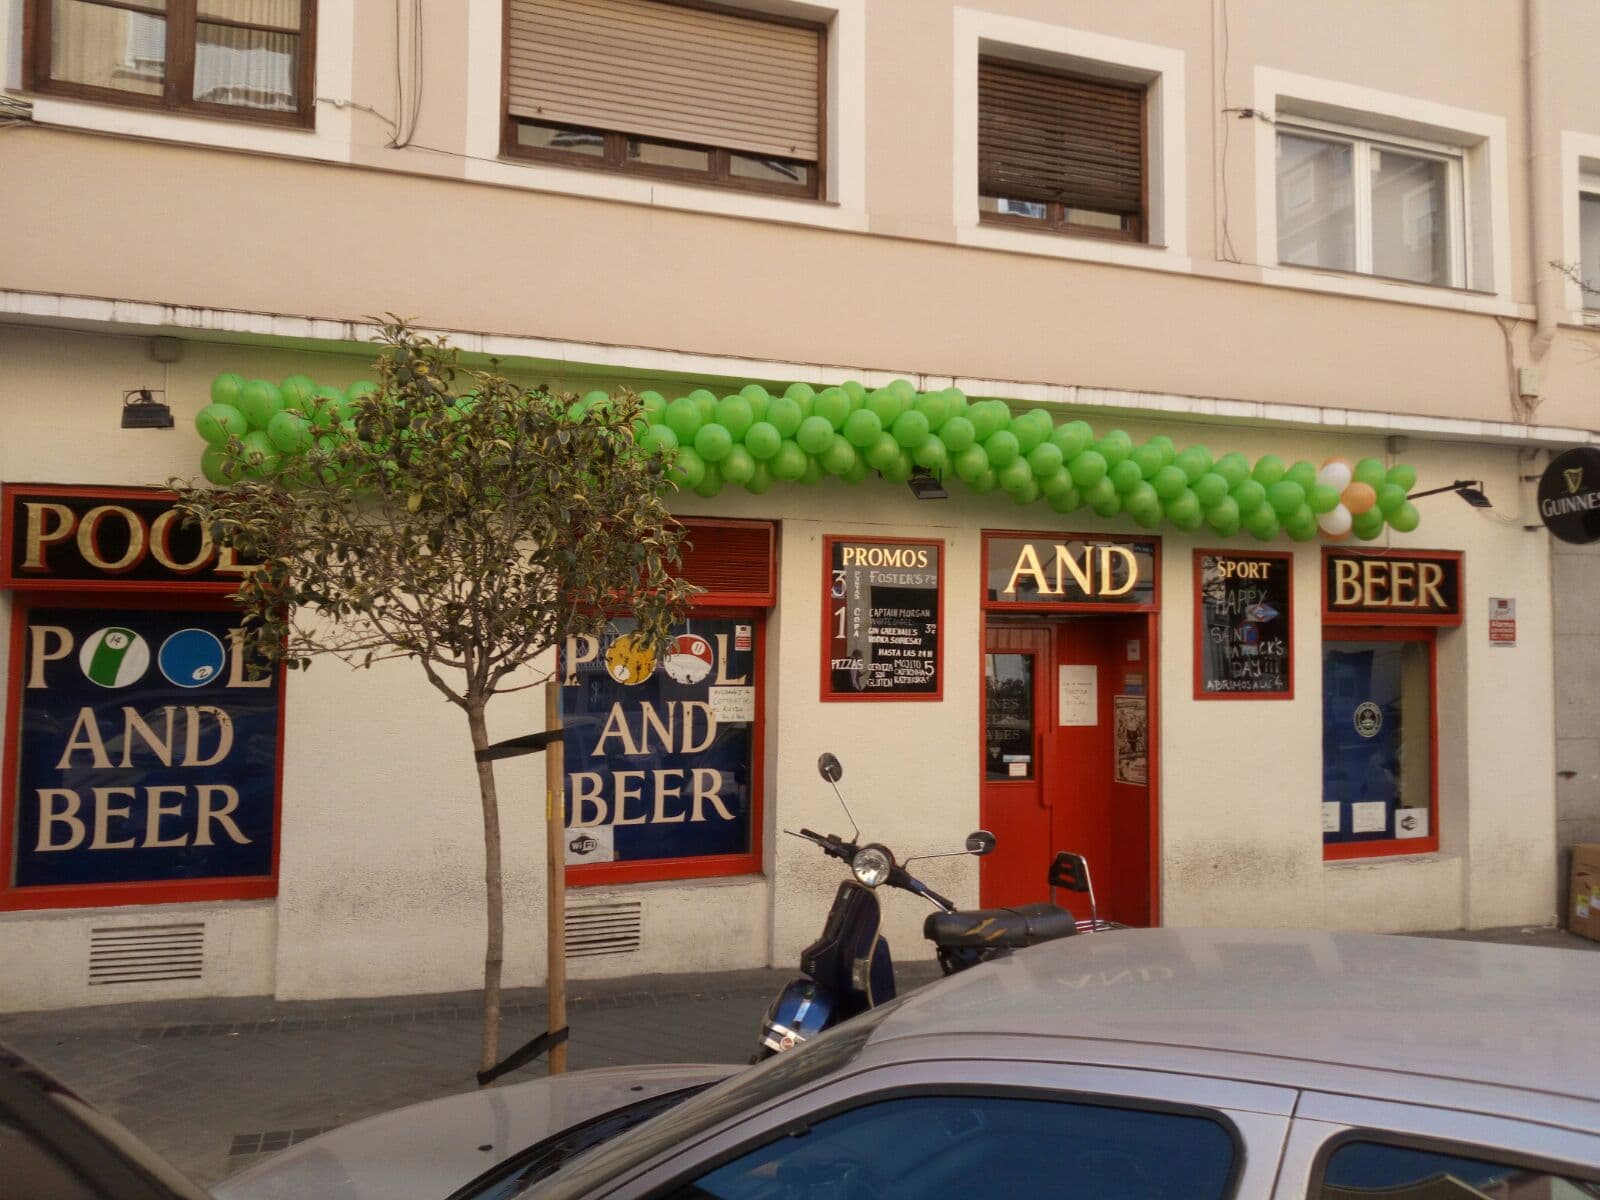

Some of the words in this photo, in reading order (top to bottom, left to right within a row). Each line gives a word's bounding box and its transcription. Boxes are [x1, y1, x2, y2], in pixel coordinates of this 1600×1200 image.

[843, 547, 928, 568] PROMOS
[1003, 544, 1139, 596] AND
[1217, 560, 1271, 579] SPORT
[1334, 559, 1448, 608] BEER
[56, 706, 235, 769] AND
[591, 700, 718, 756] AND
[34, 784, 254, 853] BEER
[568, 767, 737, 829] BEER
